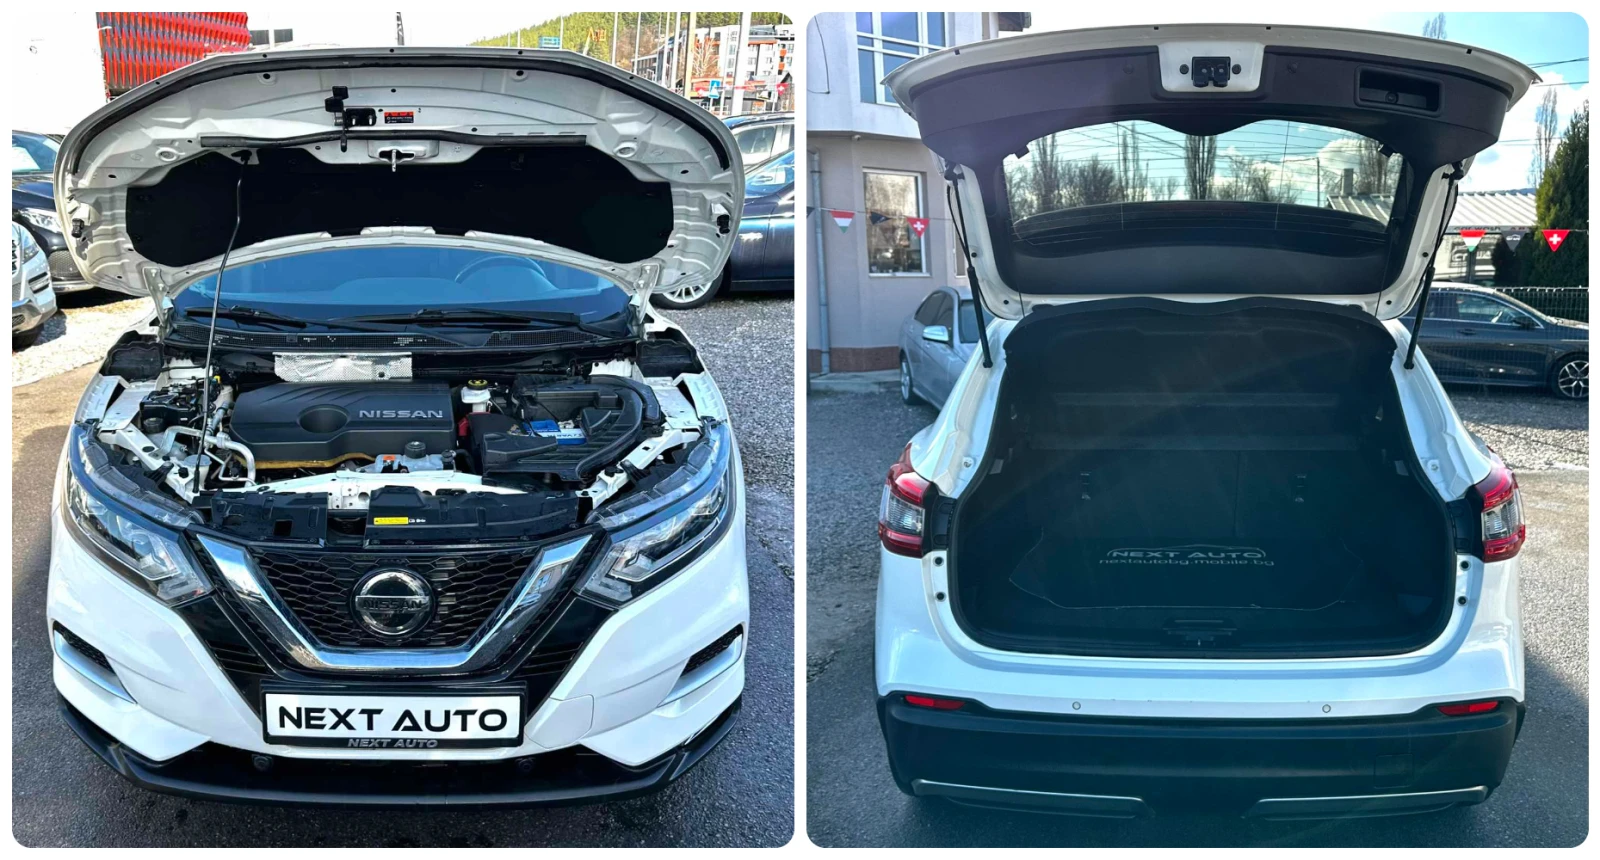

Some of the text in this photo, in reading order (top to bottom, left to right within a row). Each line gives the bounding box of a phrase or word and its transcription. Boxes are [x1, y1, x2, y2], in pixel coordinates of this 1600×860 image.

[359, 410, 443, 418] NISSAN
[361, 600, 422, 609] NISSAN
[279, 706, 508, 733] NEXT AUTO
[347, 738, 438, 748] NEXT AUTO
